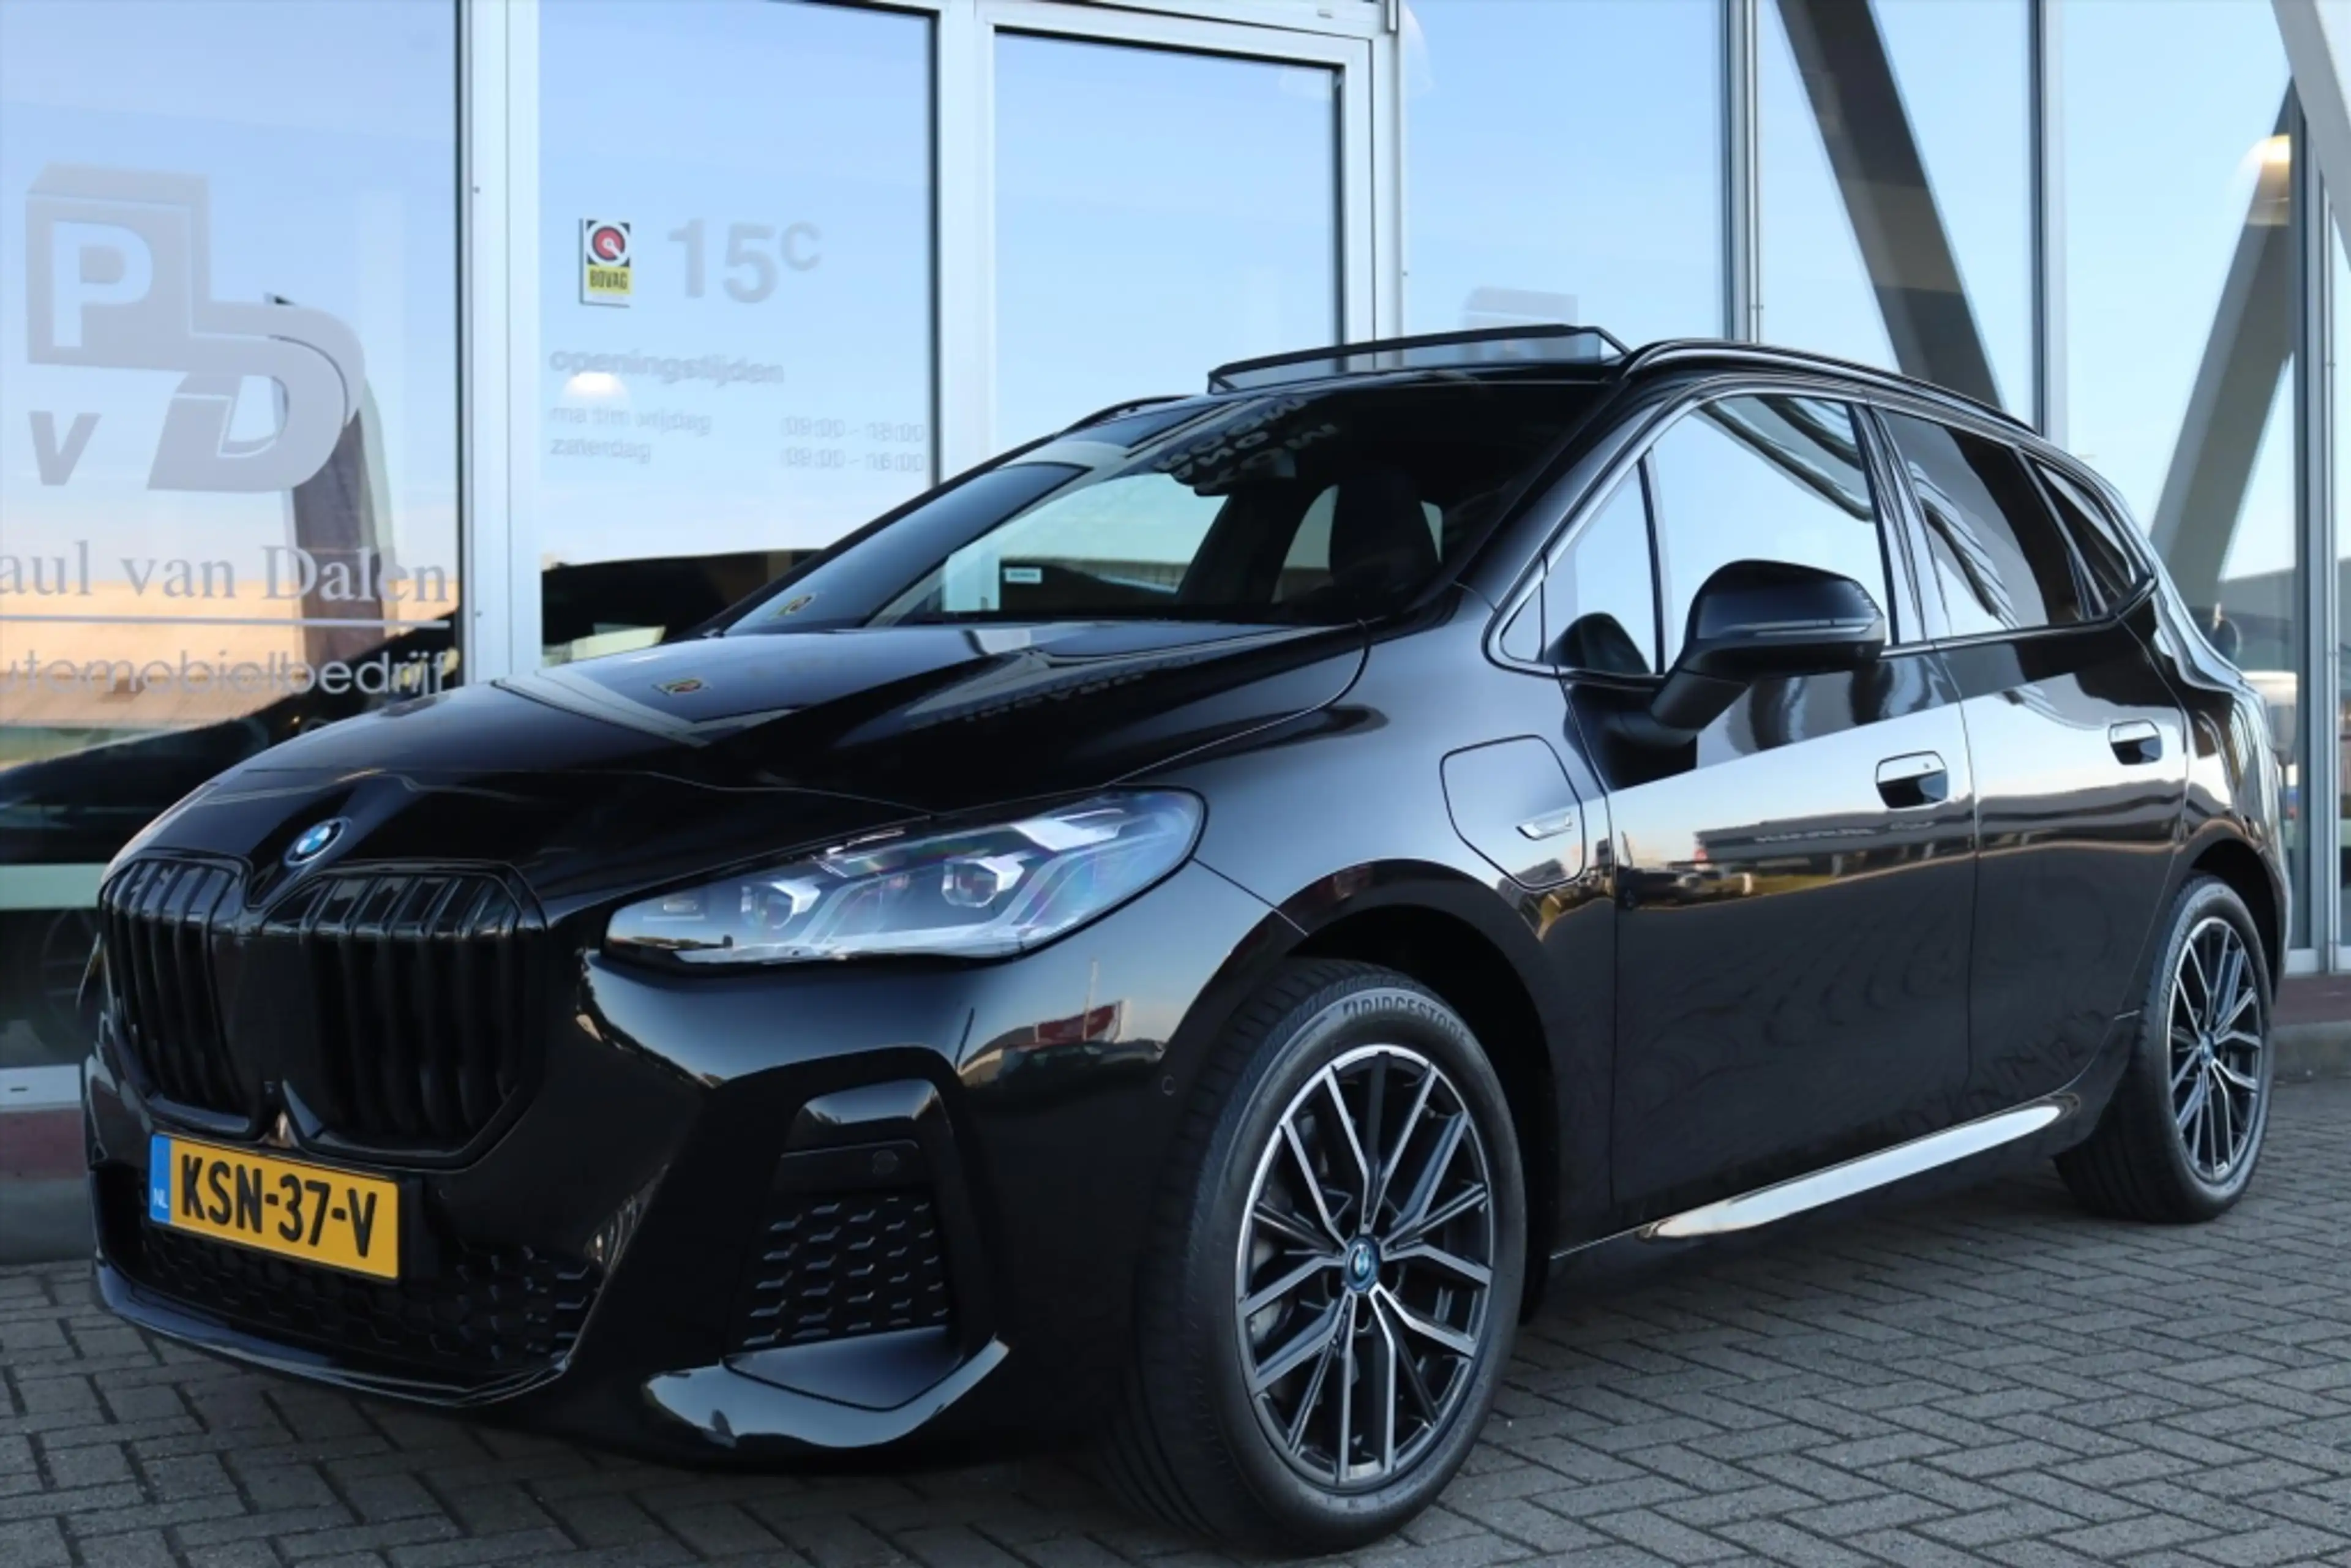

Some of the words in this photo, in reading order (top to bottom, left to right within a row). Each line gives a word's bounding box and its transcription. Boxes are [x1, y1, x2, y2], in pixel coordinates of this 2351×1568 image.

[590, 268, 628, 290] BOVAG
[549, 348, 785, 388] openingstijden
[550, 438, 652, 465] zaterdag
[121, 555, 236, 599] van
[260, 546, 449, 602] Dalen
[153, 1188, 169, 1209] NL
[181, 1153, 378, 1258] KSN-37-V
